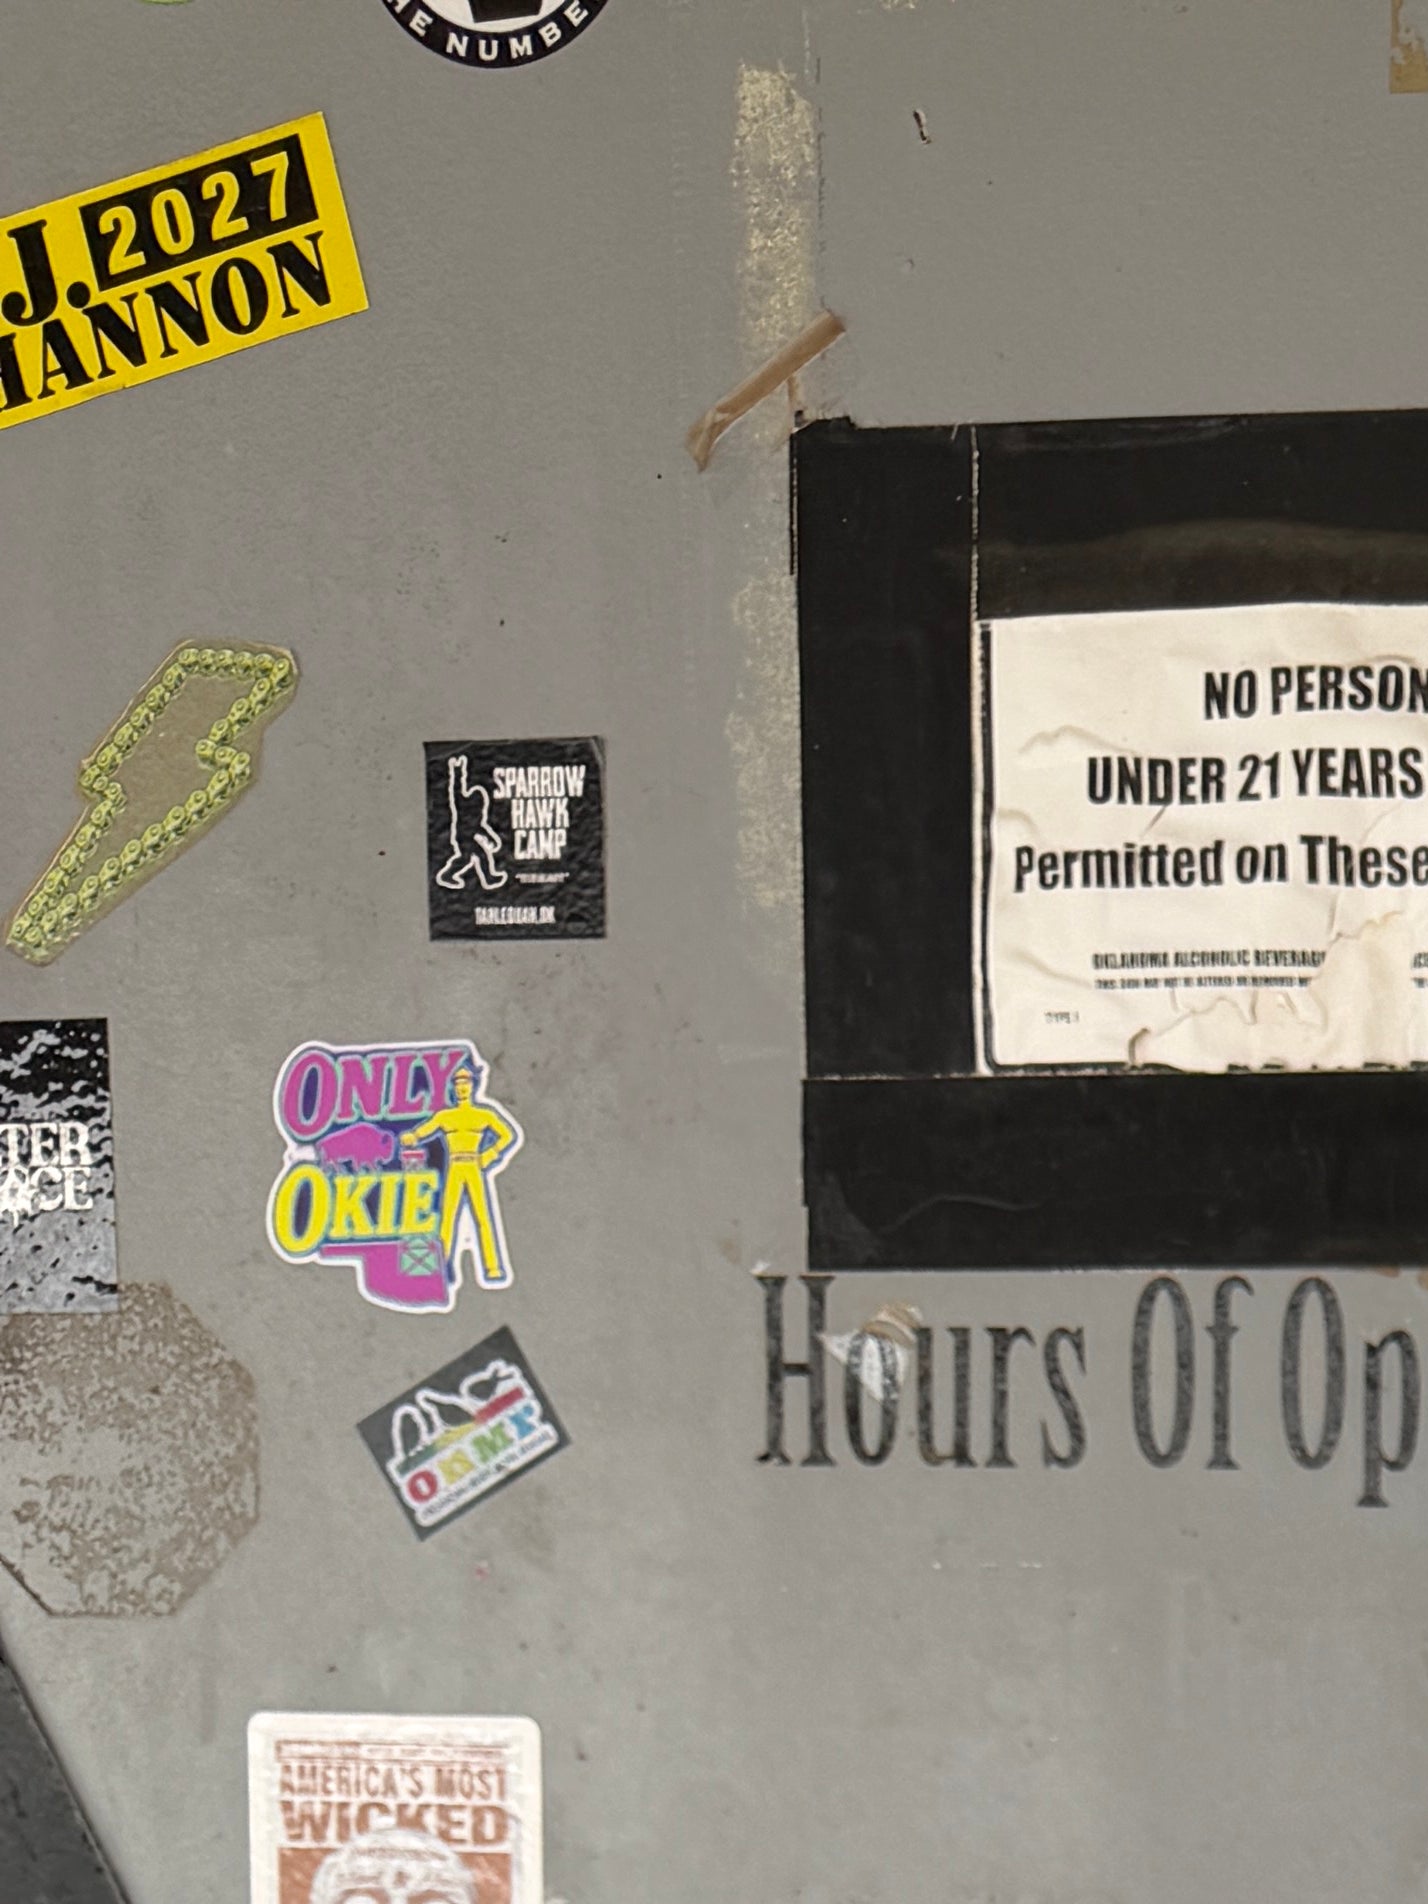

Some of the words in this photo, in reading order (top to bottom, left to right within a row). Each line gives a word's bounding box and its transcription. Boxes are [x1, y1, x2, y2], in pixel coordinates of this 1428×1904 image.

[99, 151, 289, 275] 2027
[1204, 670, 1256, 719] NO
[493, 764, 586, 799] SPARROW
[1087, 756, 1225, 805] UNDER
[1239, 752, 1280, 800] 21
[1292, 748, 1423, 797] YEARS
[511, 797, 569, 829] HAWK
[514, 829, 567, 860] CAMP
[1014, 839, 1224, 893] Permitted
[1236, 843, 1286, 882] on
[283, 1051, 467, 1137] ONLY
[274, 1164, 440, 1254] OKIE
[755, 1275, 1087, 1468] Hours
[1131, 1276, 1255, 1471] Of
[280, 1763, 425, 1798] AMERICA'S
[435, 1766, 506, 1801] MOST
[281, 1800, 509, 1845] WICKED
